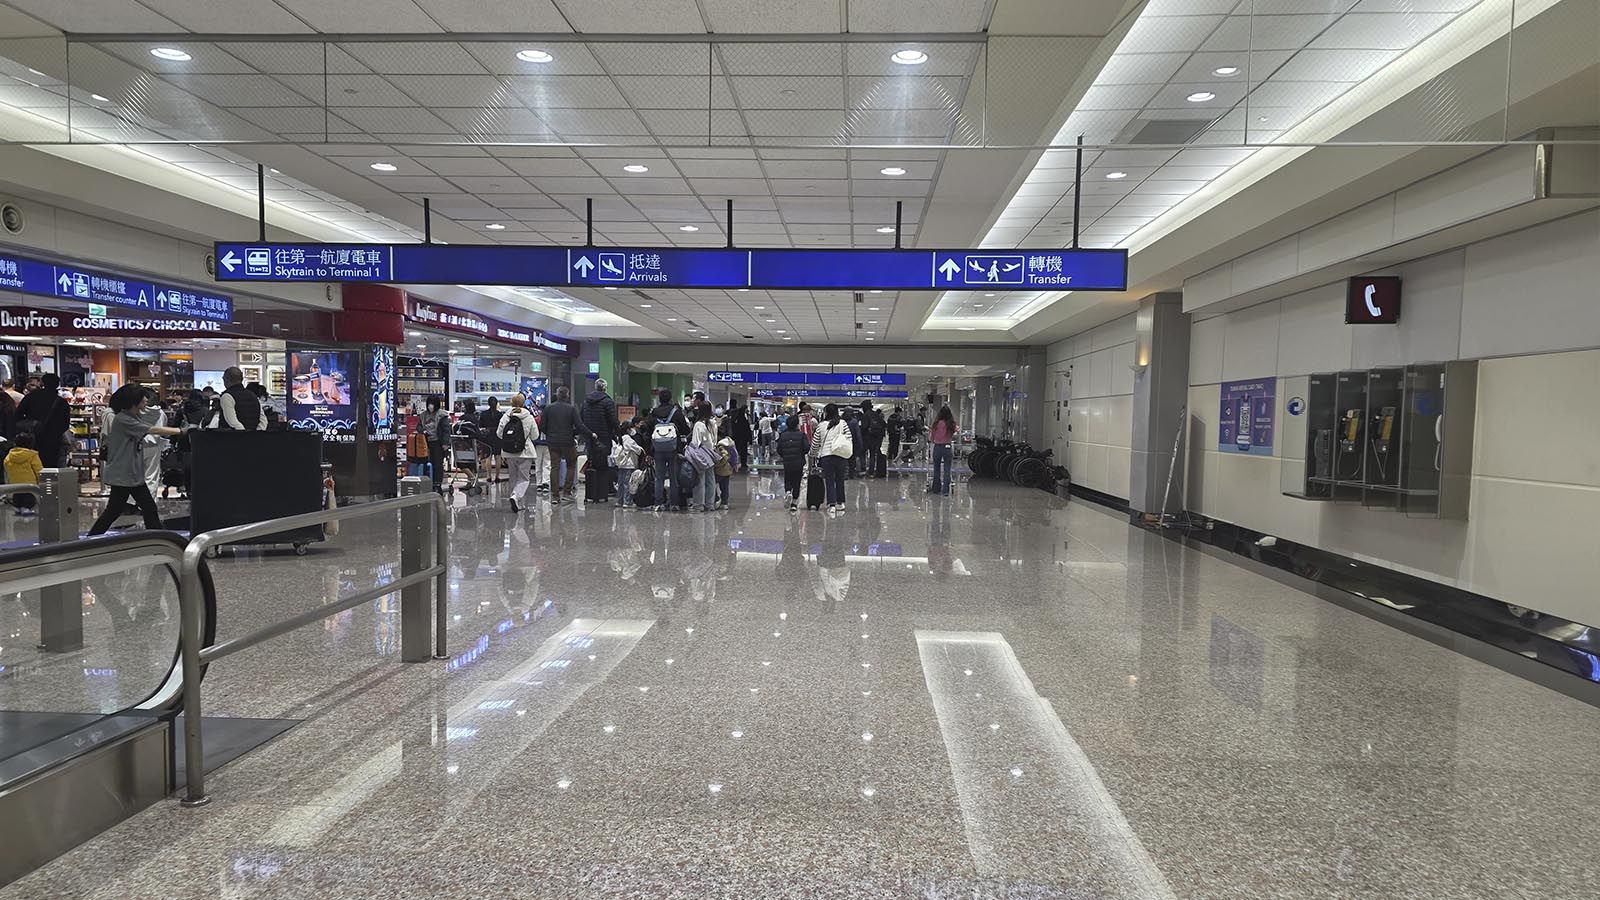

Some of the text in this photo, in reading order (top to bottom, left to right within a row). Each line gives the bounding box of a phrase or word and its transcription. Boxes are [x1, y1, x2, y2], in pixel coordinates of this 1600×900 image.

[274, 249, 381, 265] 往第一航廈電車
[629, 253, 661, 270] 抵達
[1028, 255, 1063, 272] 轉機
[275, 266, 380, 279] Skytrain to Terminal 1
[629, 271, 668, 282] Arrivals
[1028, 273, 1072, 284] Transfer
[0, 277, 24, 288] ransfer
[91, 290, 137, 306] Transfer counter
[138, 289, 149, 308] A
[0, 310, 59, 331] DutyFree
